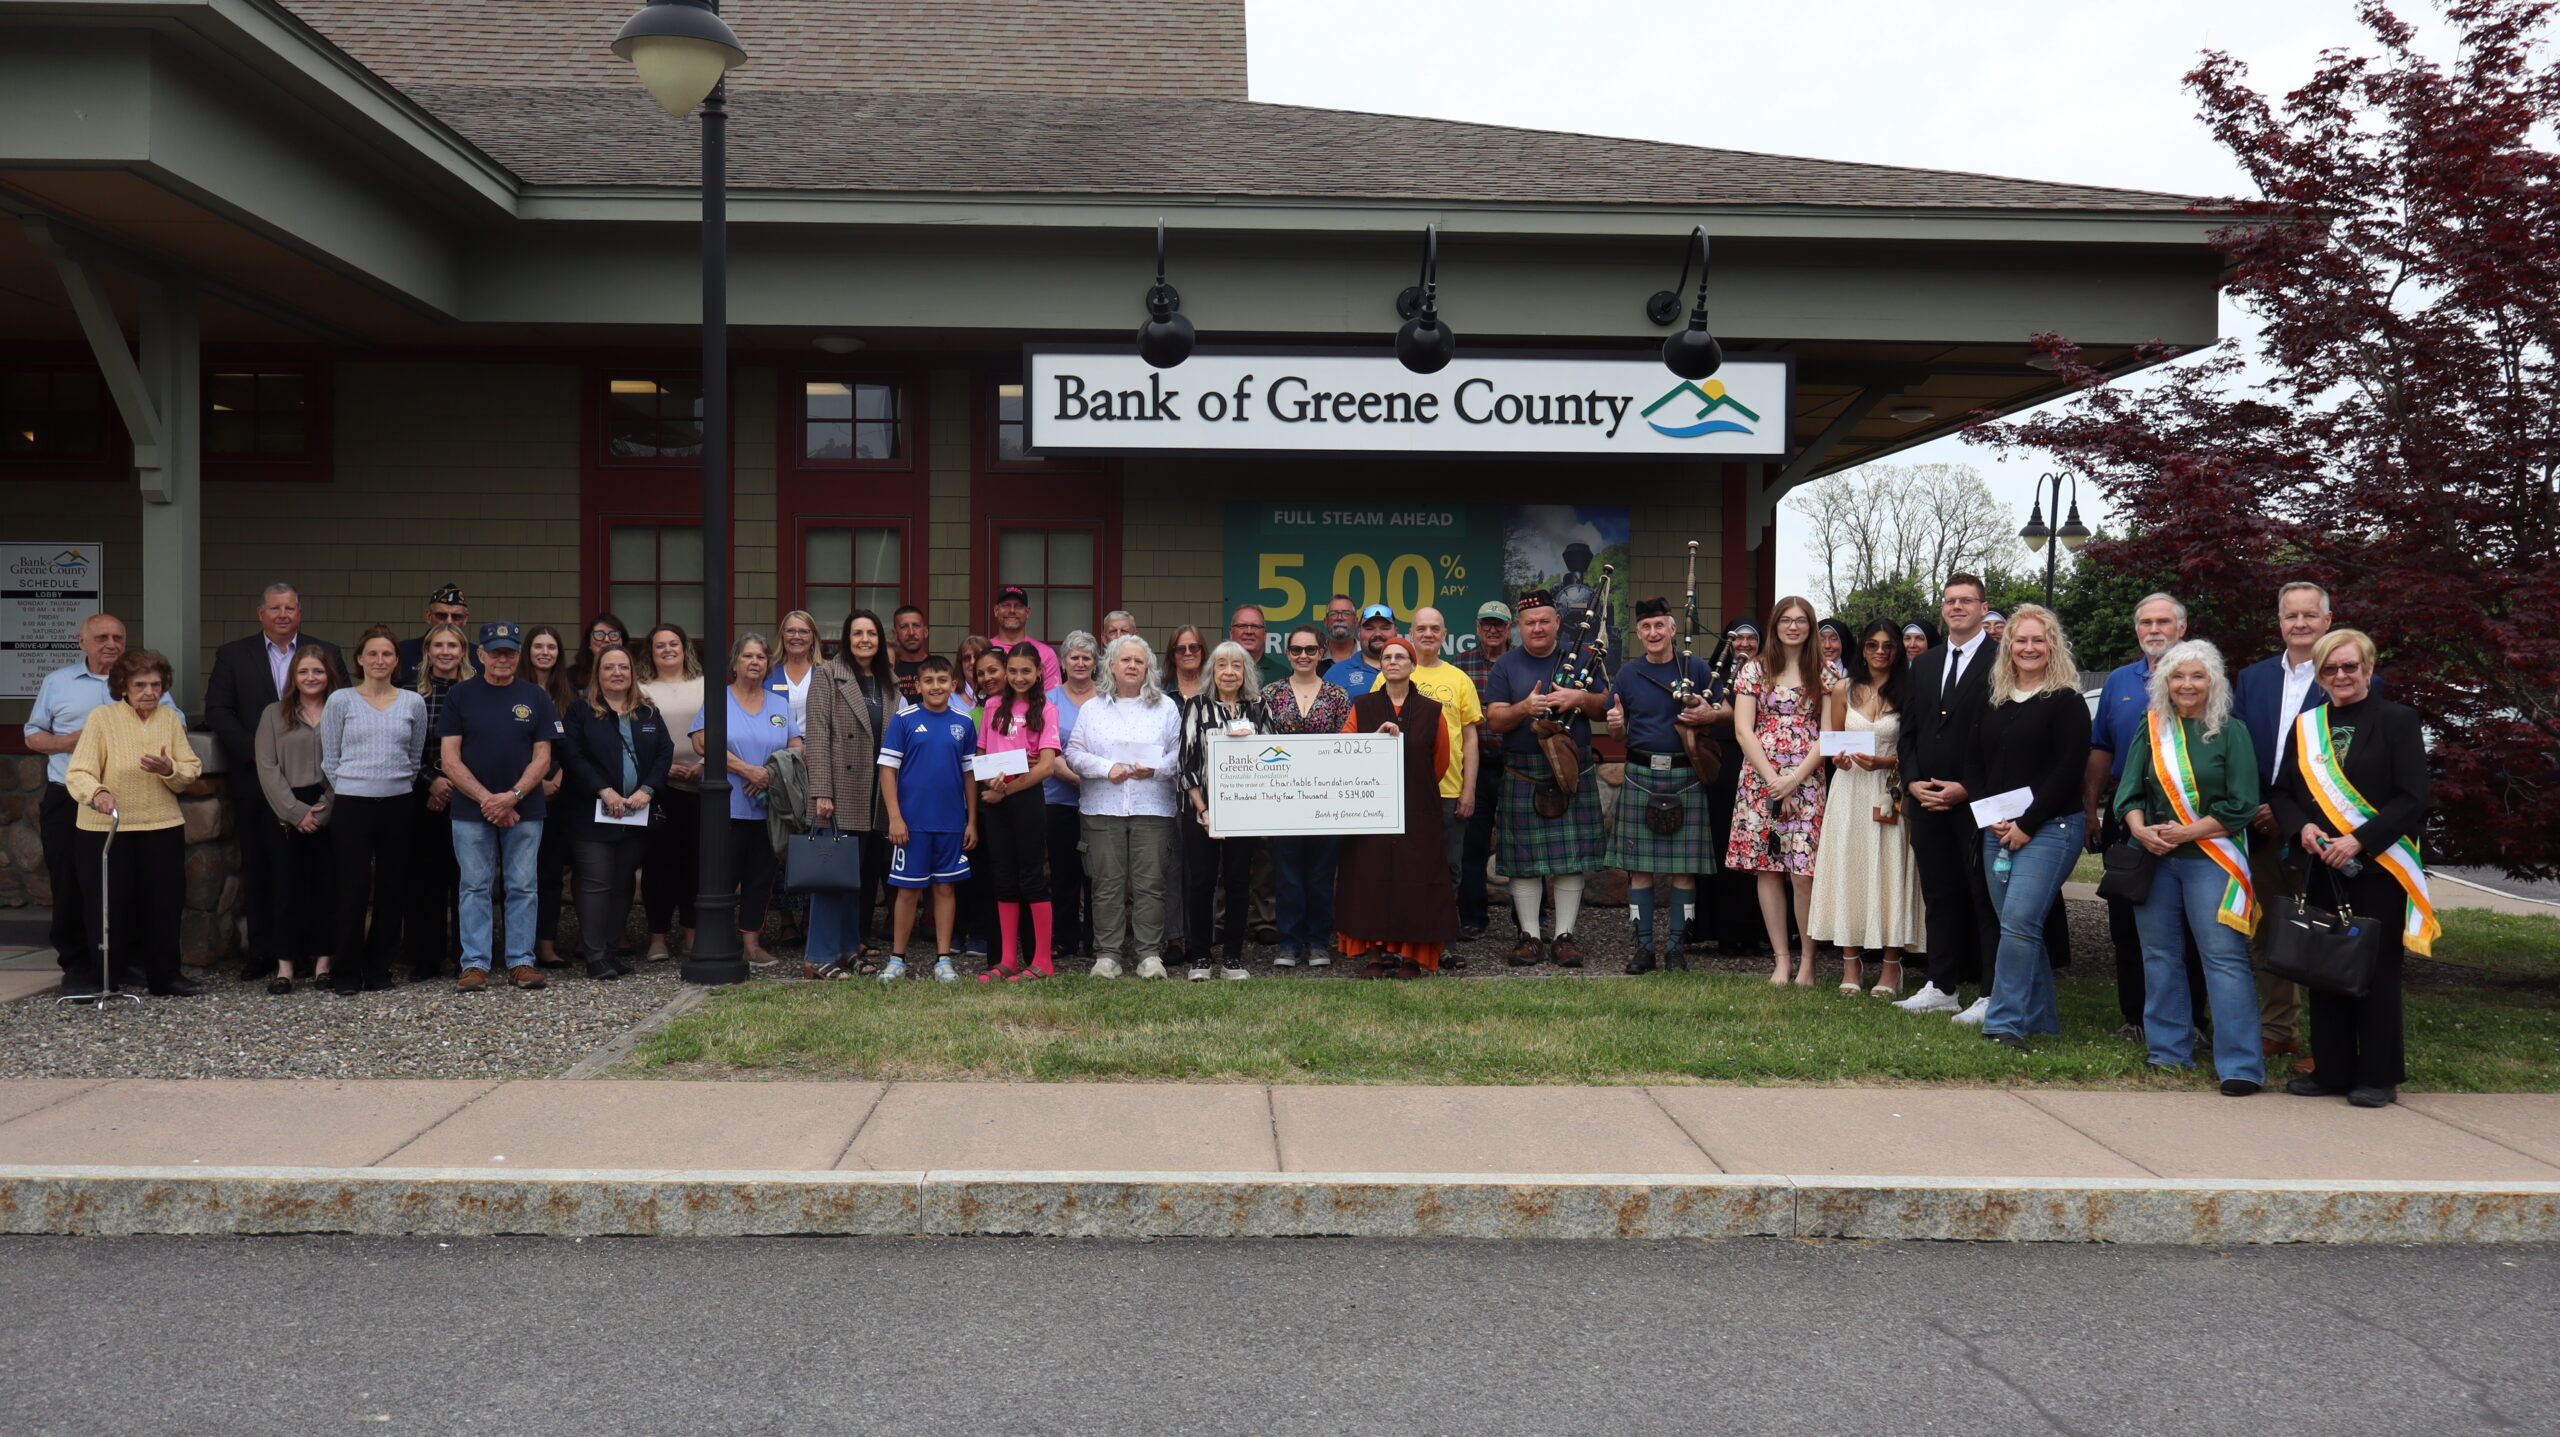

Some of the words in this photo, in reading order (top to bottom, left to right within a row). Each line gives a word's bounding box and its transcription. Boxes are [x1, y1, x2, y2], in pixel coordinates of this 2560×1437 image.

[1053, 372, 1181, 421] Bank
[1197, 374, 1254, 422] of
[1266, 376, 1439, 424] Greene
[1453, 377, 1634, 439] County
[1273, 510, 1317, 525] FULL
[1321, 511, 1384, 526] STEAM
[1389, 512, 1453, 527] AHEAD
[20, 556, 47, 567] Bank
[10, 564, 48, 575] Greene
[49, 564, 88, 577] County
[19, 579, 80, 588] SCHEDULE
[1333, 740, 1372, 754] 2026
[1228, 754, 1253, 765] Bank
[1219, 762, 1254, 772] Greene
[1255, 762, 1291, 773] County
[1220, 772, 1252, 780] Charitable
[1270, 777, 1312, 787] Charitable
[1314, 776, 1353, 786] Foundation
[1355, 776, 1380, 786] Grants
[1234, 792, 1257, 801] Hundred
[1297, 790, 1328, 799] Thousand
[1314, 810, 1331, 819] Bank
[1332, 810, 1339, 820] of
[1340, 810, 1361, 818] Greene
[1363, 809, 1384, 819] County
[891, 845, 906, 872] 19
